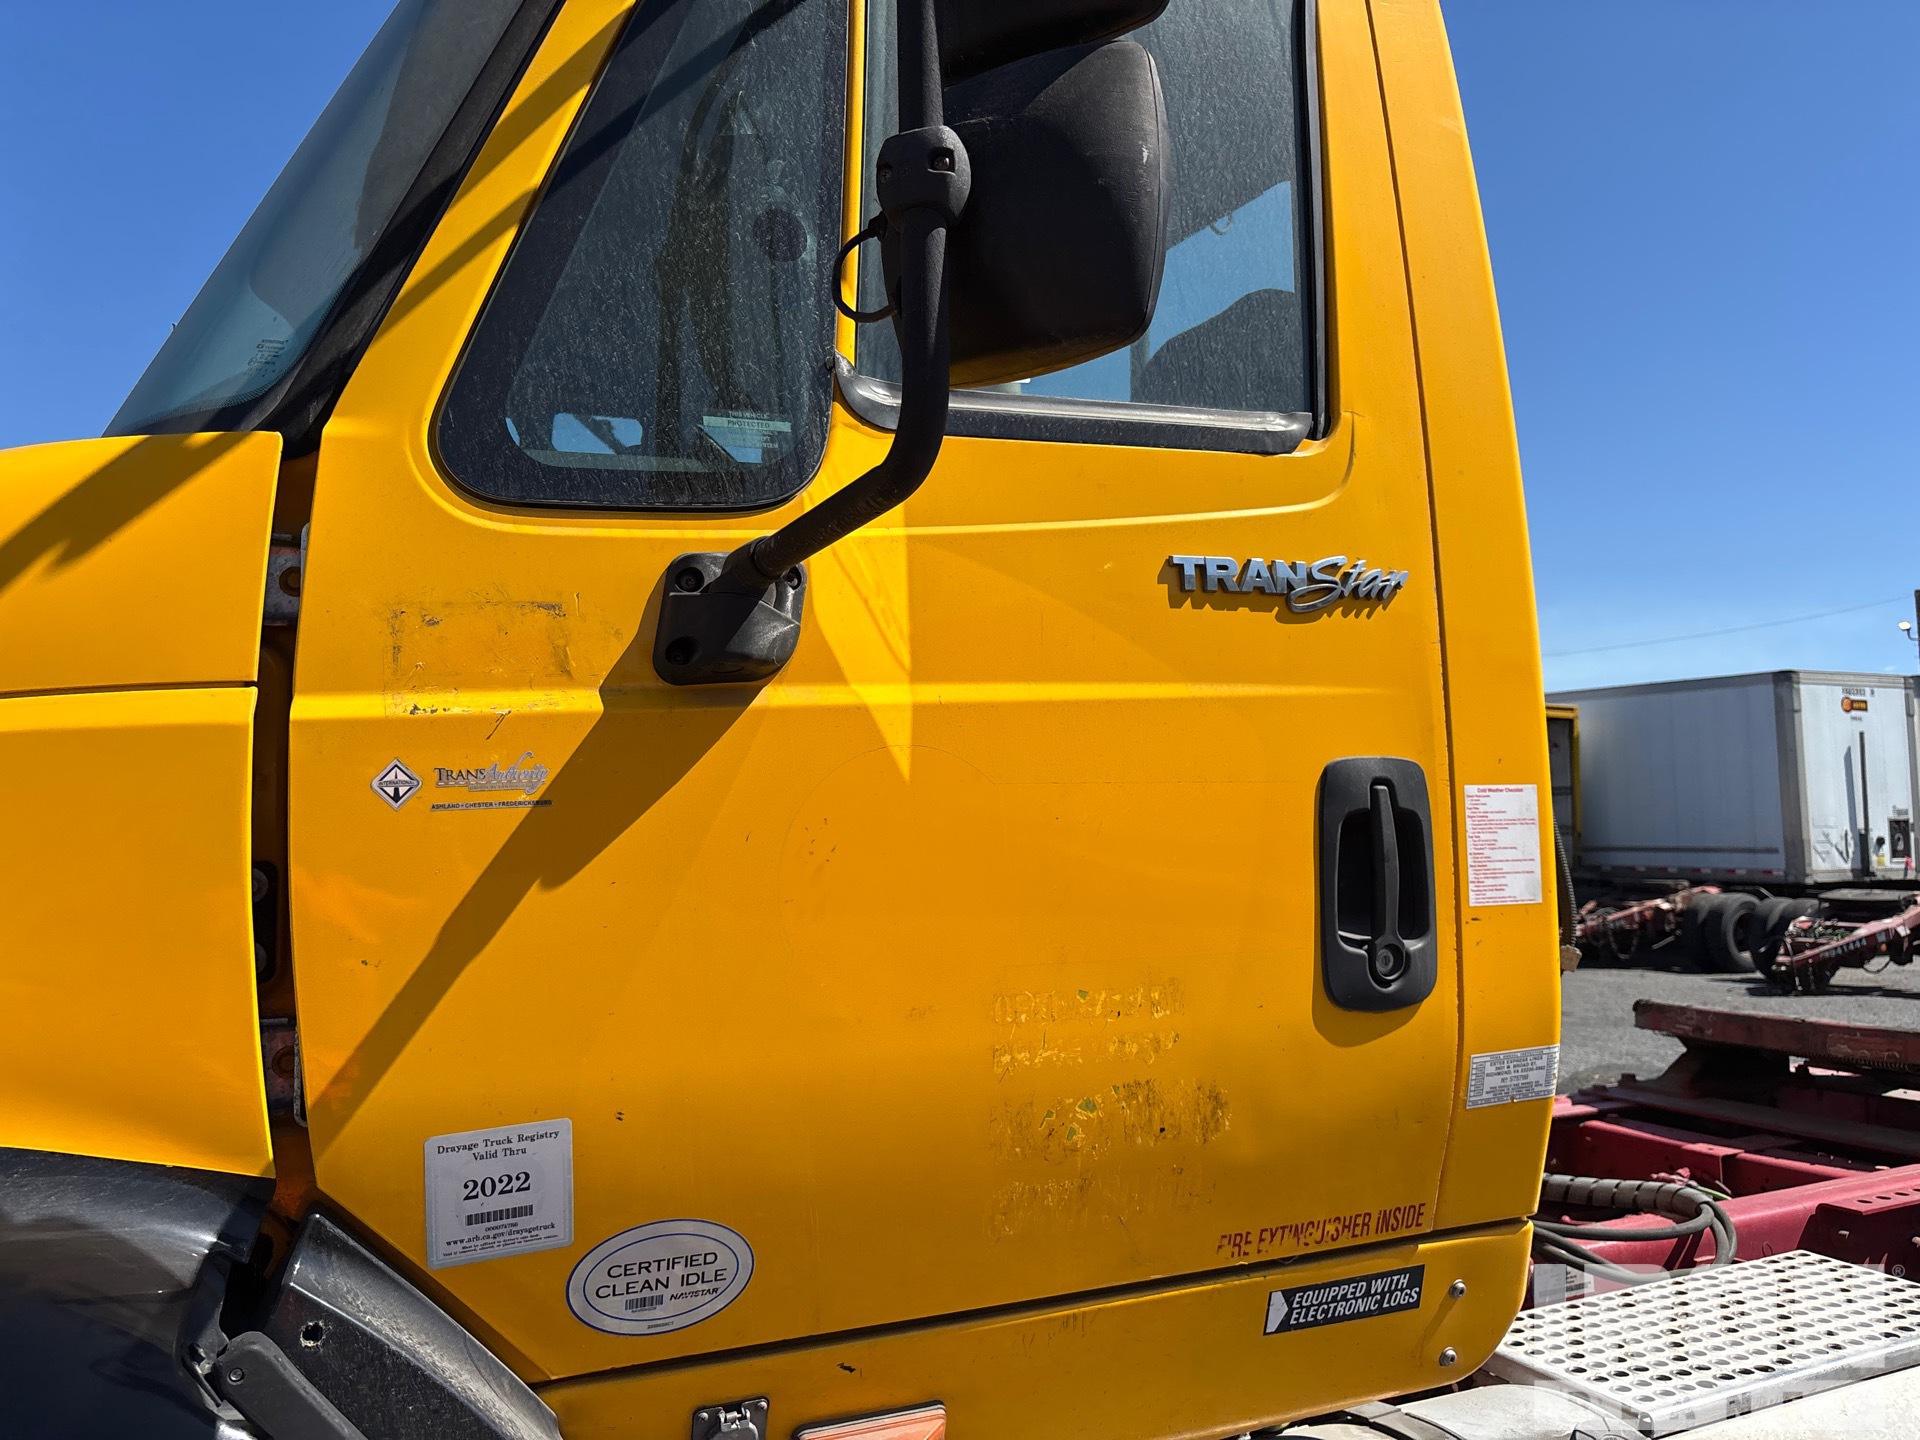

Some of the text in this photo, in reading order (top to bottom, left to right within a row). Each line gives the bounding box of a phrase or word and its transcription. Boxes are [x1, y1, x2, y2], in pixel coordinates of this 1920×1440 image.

[378, 779, 415, 787] INTERNATIONAL
[498, 799, 553, 807] FREDERICKSBURG
[437, 1130, 560, 1154] Drayage Truck Registry
[472, 1147, 527, 1161] Valid Thru
[463, 1171, 531, 1201] 2022
[445, 1222, 555, 1246] www.arb.ca.gov/drayagetruck
[1217, 1202, 1426, 1258] FIRE EXTINGUSHER INSIDE
[607, 1252, 718, 1279] CERTIFIED
[595, 1268, 728, 1299] CLEAN IDLE
[1292, 1273, 1410, 1309] EQUIPPED WITH
[1290, 1287, 1420, 1325] ELECTRONIC LOGS
